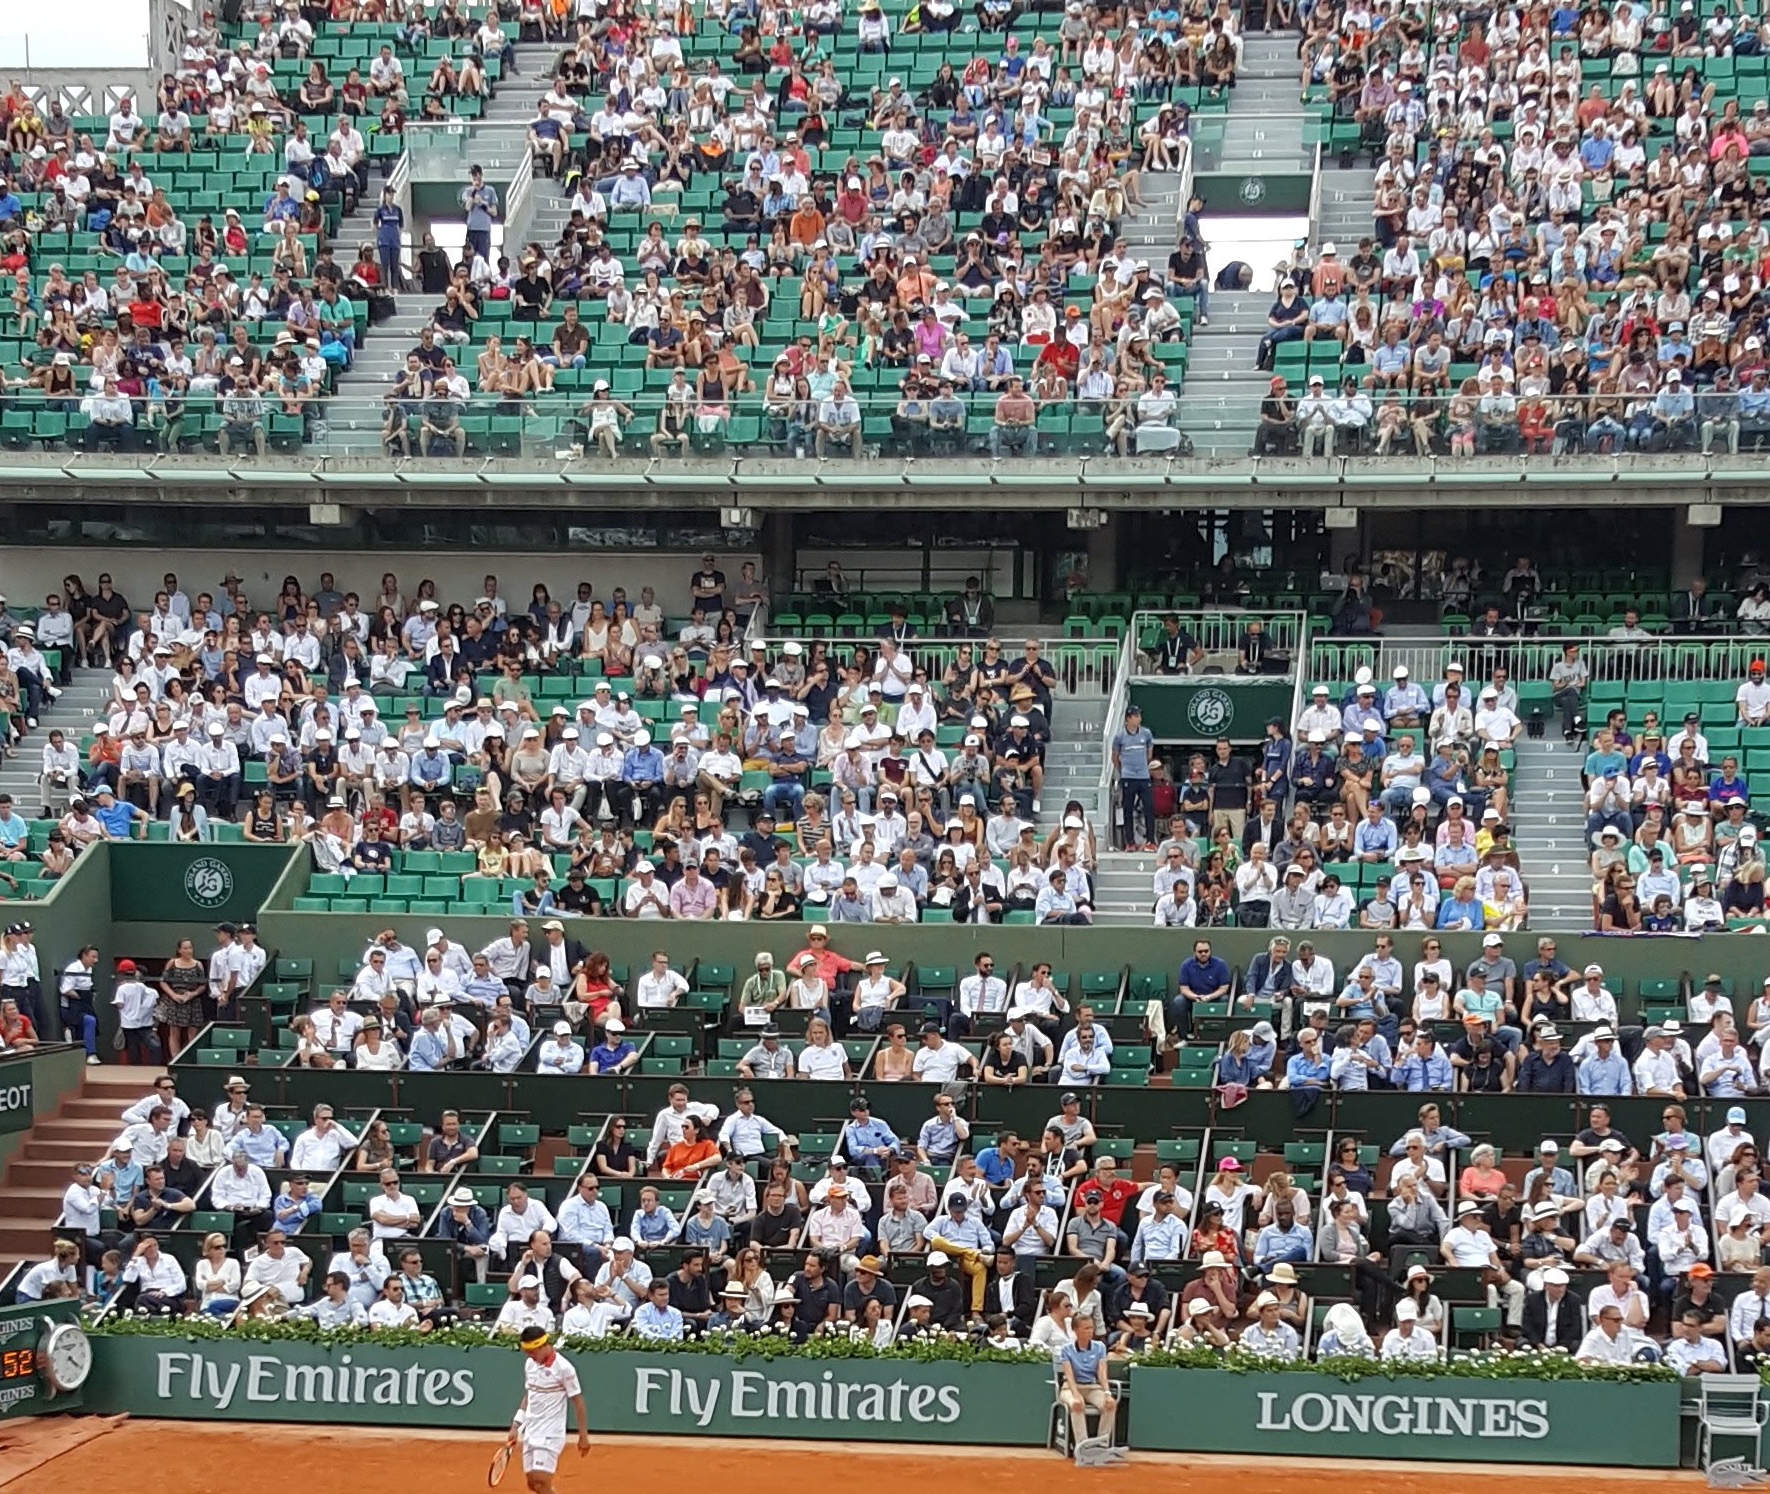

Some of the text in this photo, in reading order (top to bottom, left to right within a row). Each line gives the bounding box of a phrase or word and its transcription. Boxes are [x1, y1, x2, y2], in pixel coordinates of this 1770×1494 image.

[4, 1350, 33, 1377] 52
[157, 1352, 474, 1410] Fly Emirates
[634, 1368, 962, 1426] Fly Emirates
[1255, 1392, 1550, 1439] LONGINES
